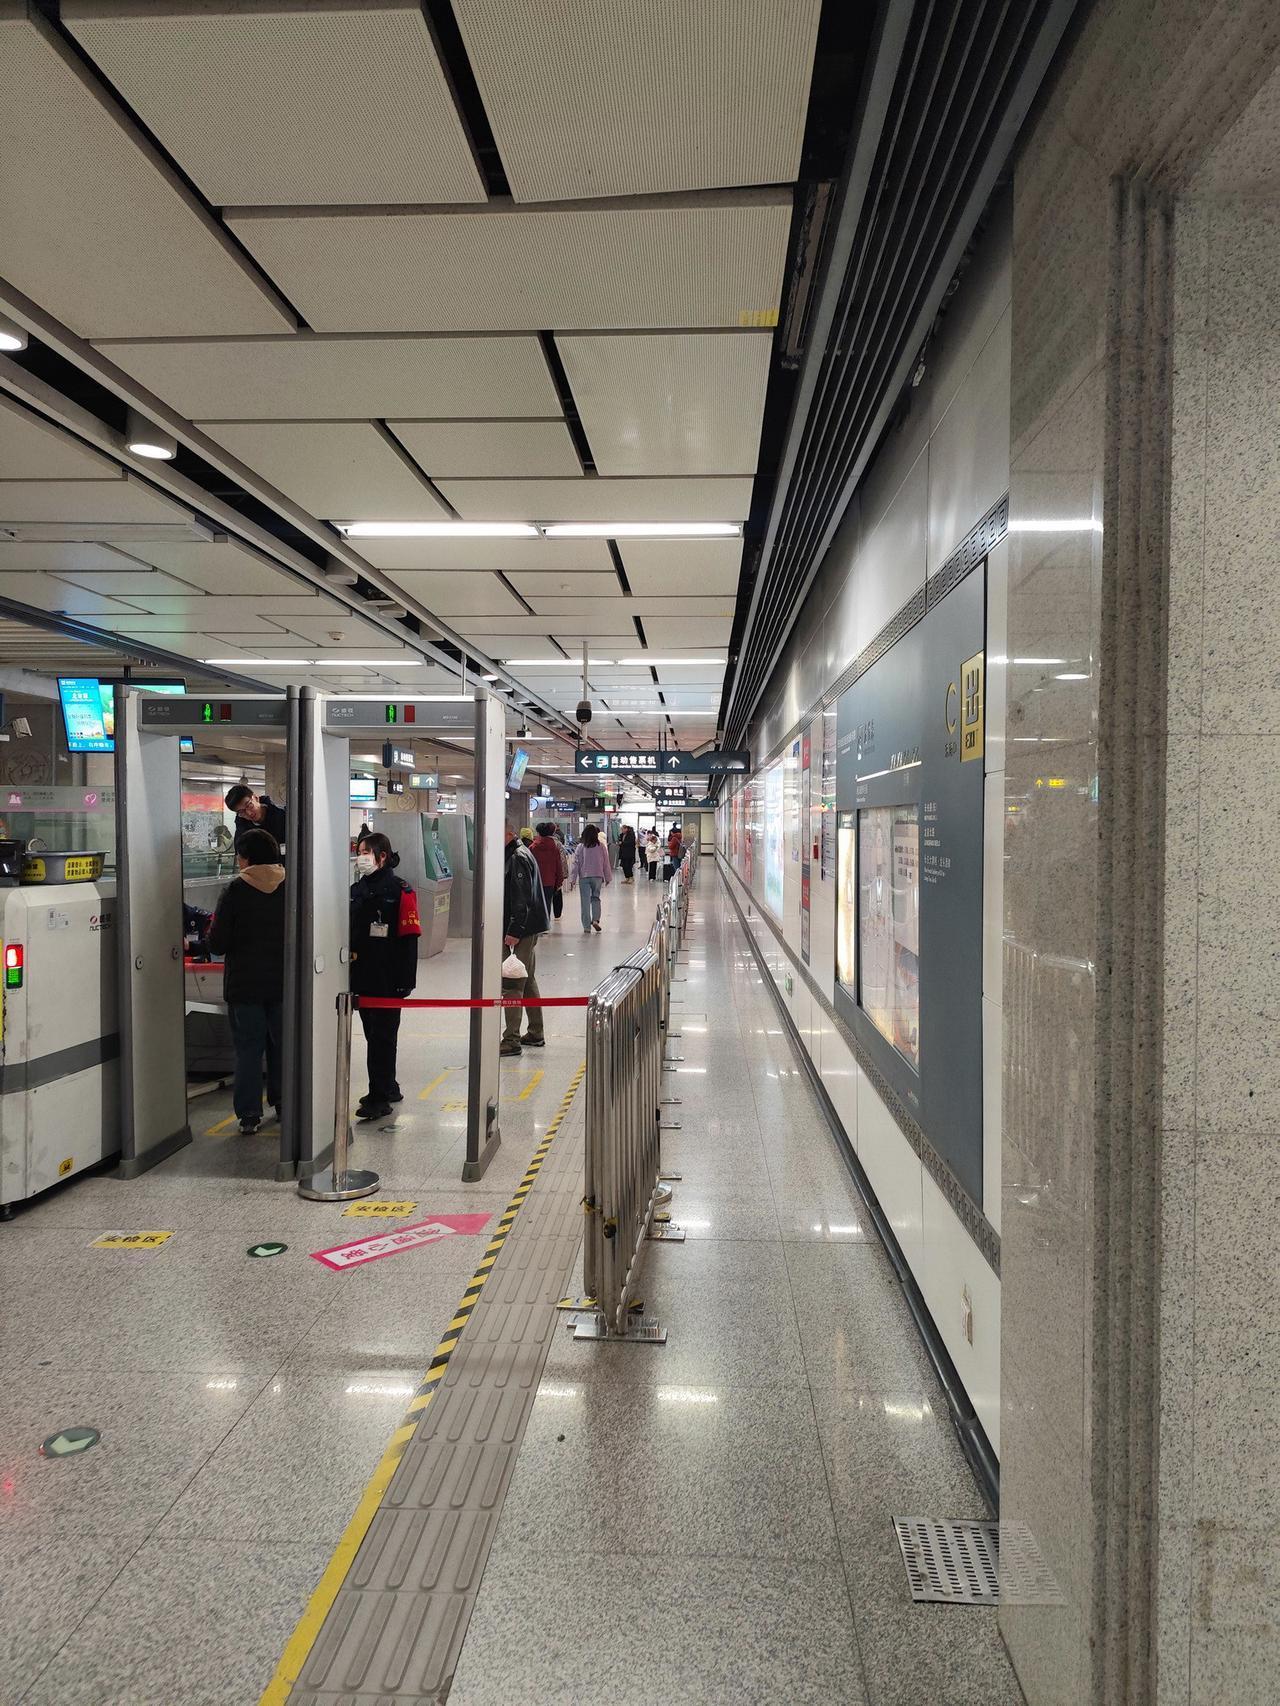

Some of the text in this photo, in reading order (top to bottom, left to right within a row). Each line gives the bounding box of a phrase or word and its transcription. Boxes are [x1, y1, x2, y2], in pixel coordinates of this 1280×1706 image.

[945, 682, 957, 735] C
[965, 730, 979, 750] EXIT
[611, 755, 656, 764] 自动售票机
[356, 1205, 409, 1214] 安检区
[102, 1232, 163, 1245] 安检区
